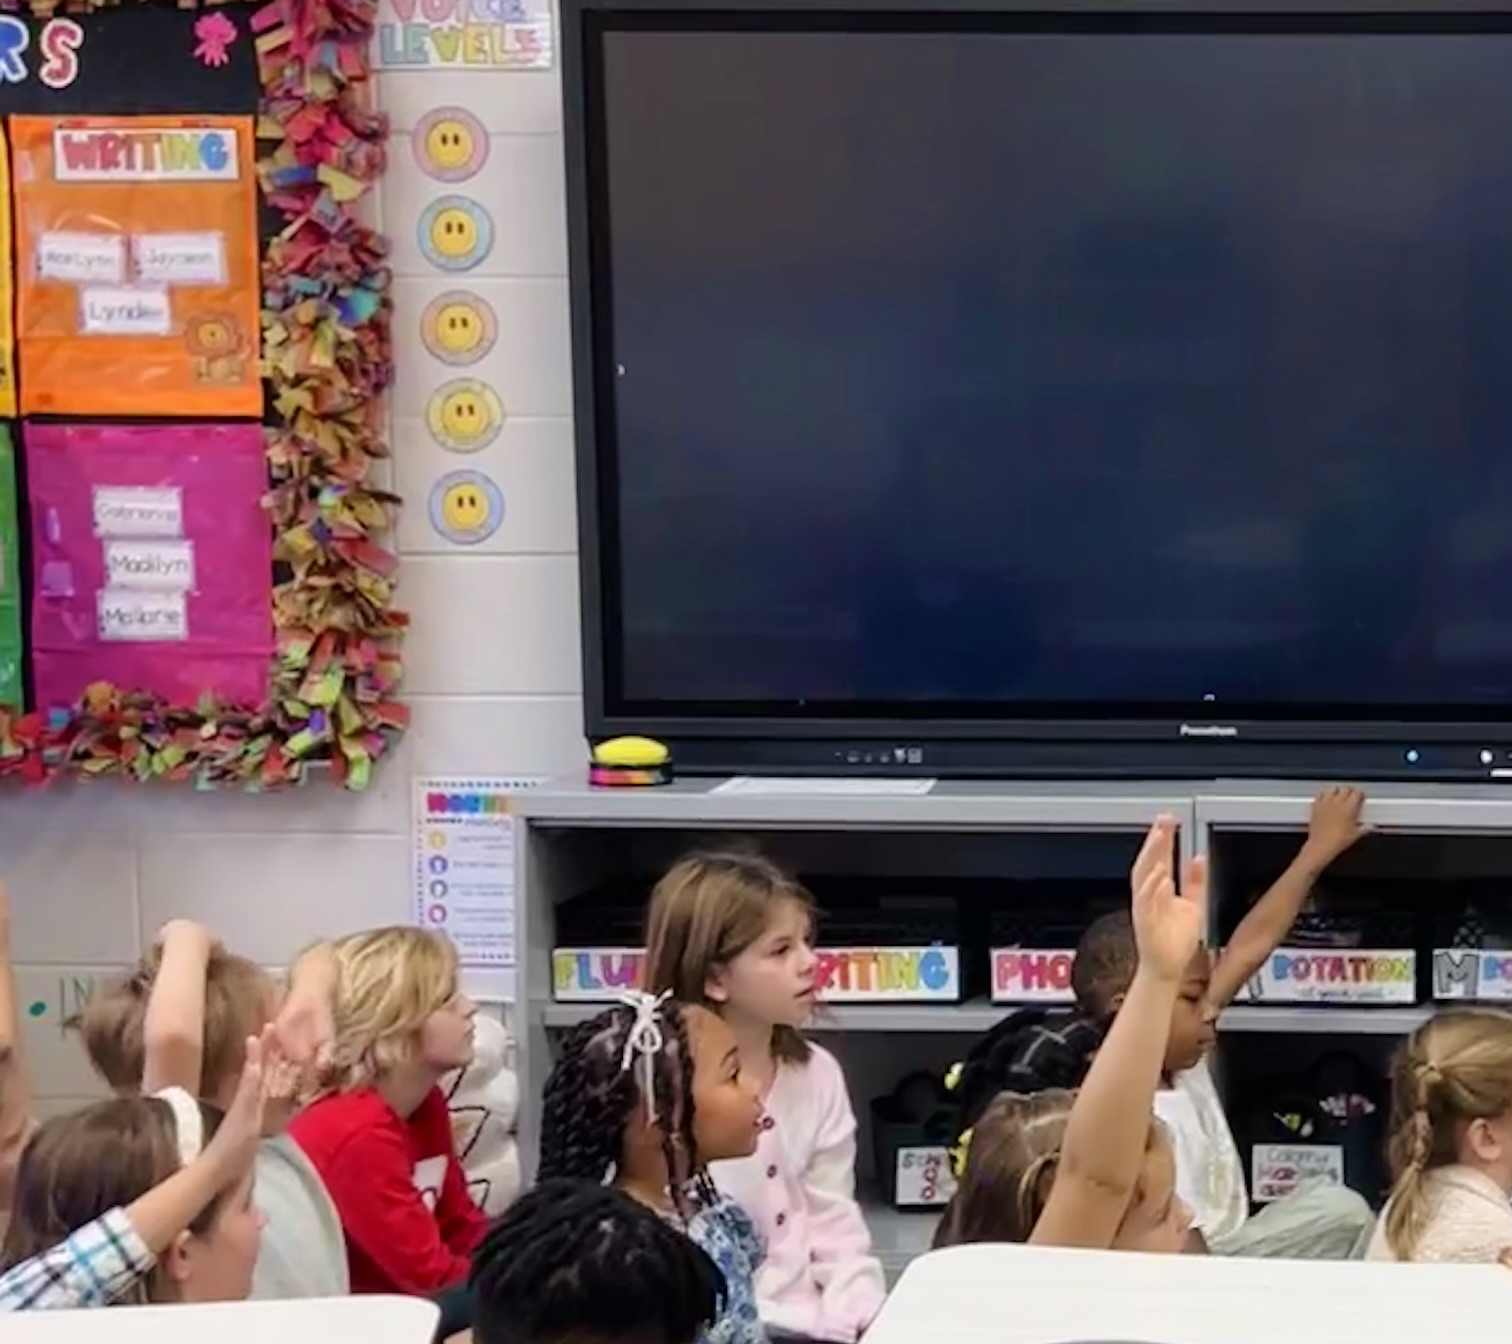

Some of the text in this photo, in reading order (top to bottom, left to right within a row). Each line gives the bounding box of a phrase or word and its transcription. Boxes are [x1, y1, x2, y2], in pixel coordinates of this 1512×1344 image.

[378, 24, 545, 66] LEVELS
[60, 131, 230, 171] WRITING
[814, 950, 950, 992] RITING
[1272, 953, 1411, 984] ROTATION
